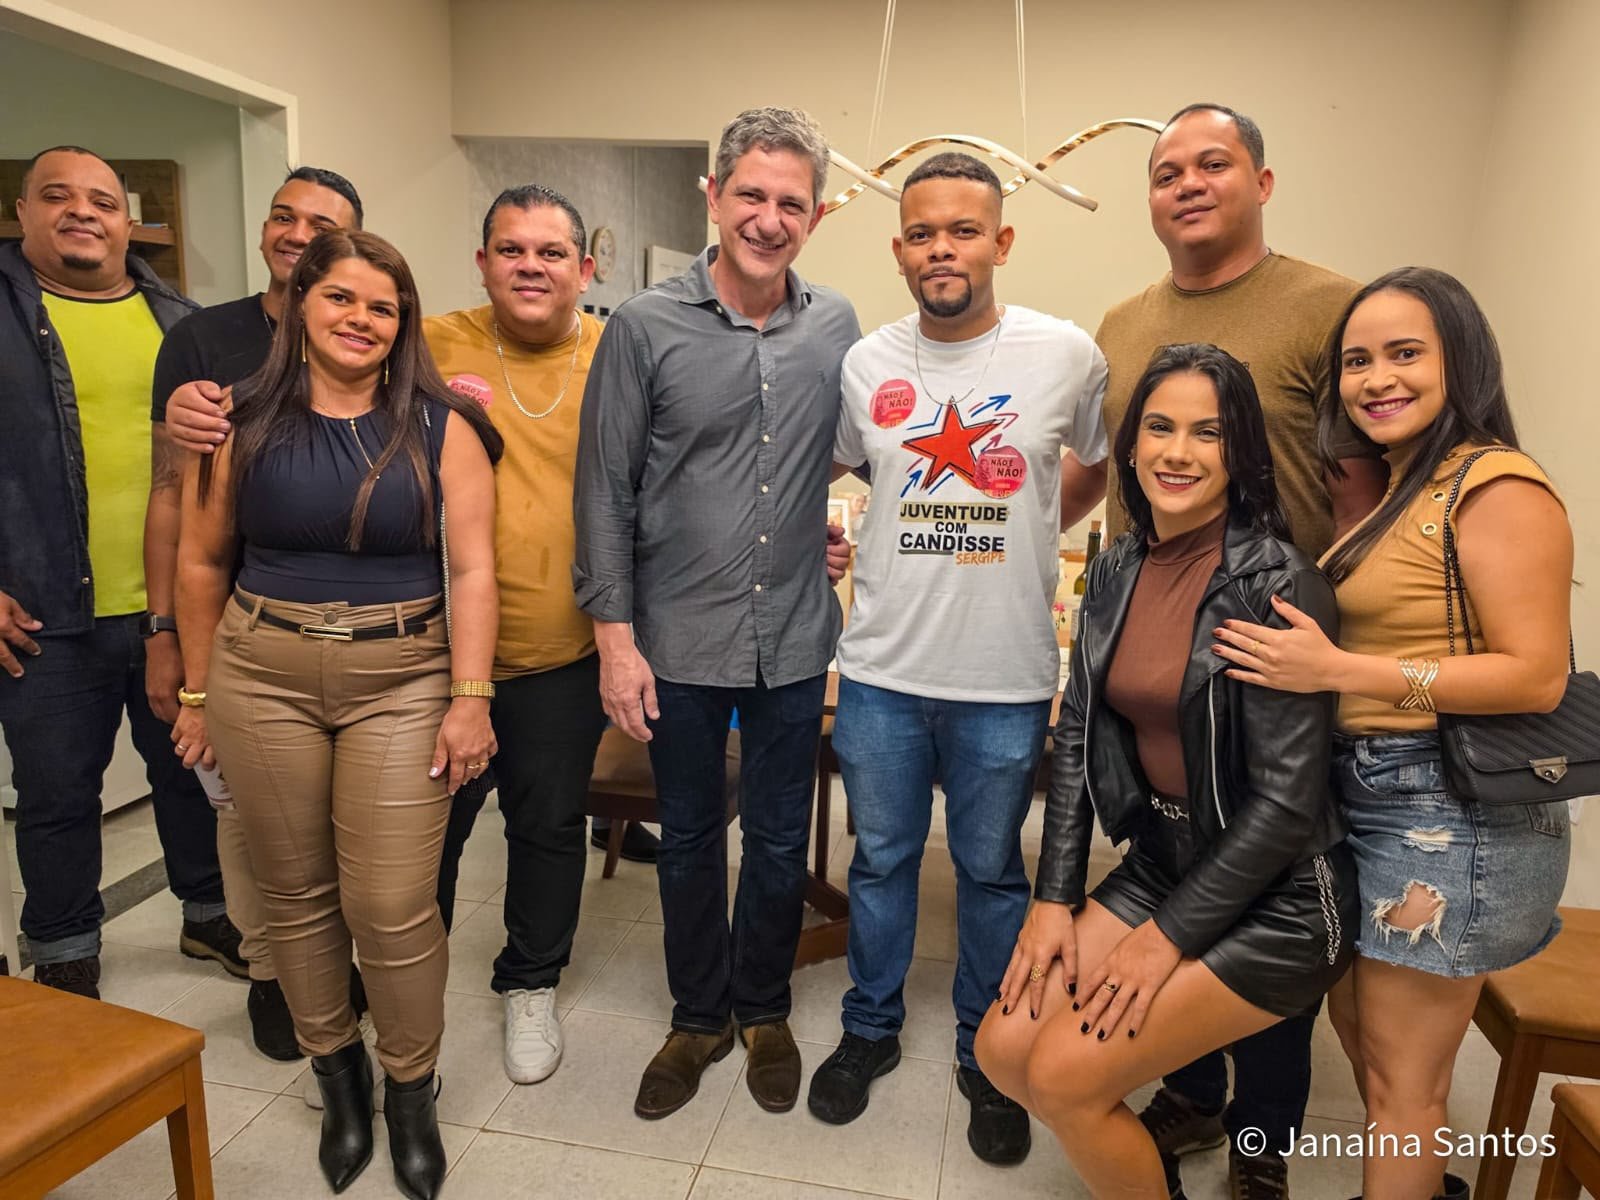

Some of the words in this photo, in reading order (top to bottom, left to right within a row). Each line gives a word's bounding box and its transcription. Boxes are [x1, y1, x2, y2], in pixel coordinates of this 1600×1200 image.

[888, 397, 913, 409] NÃO!
[996, 466, 1023, 478] NÃO!
[899, 503, 1008, 521] JUVENTUDE
[934, 521, 968, 534] COM
[899, 532, 1006, 552] CANDISSE
[955, 551, 1006, 566] SERGIPE
